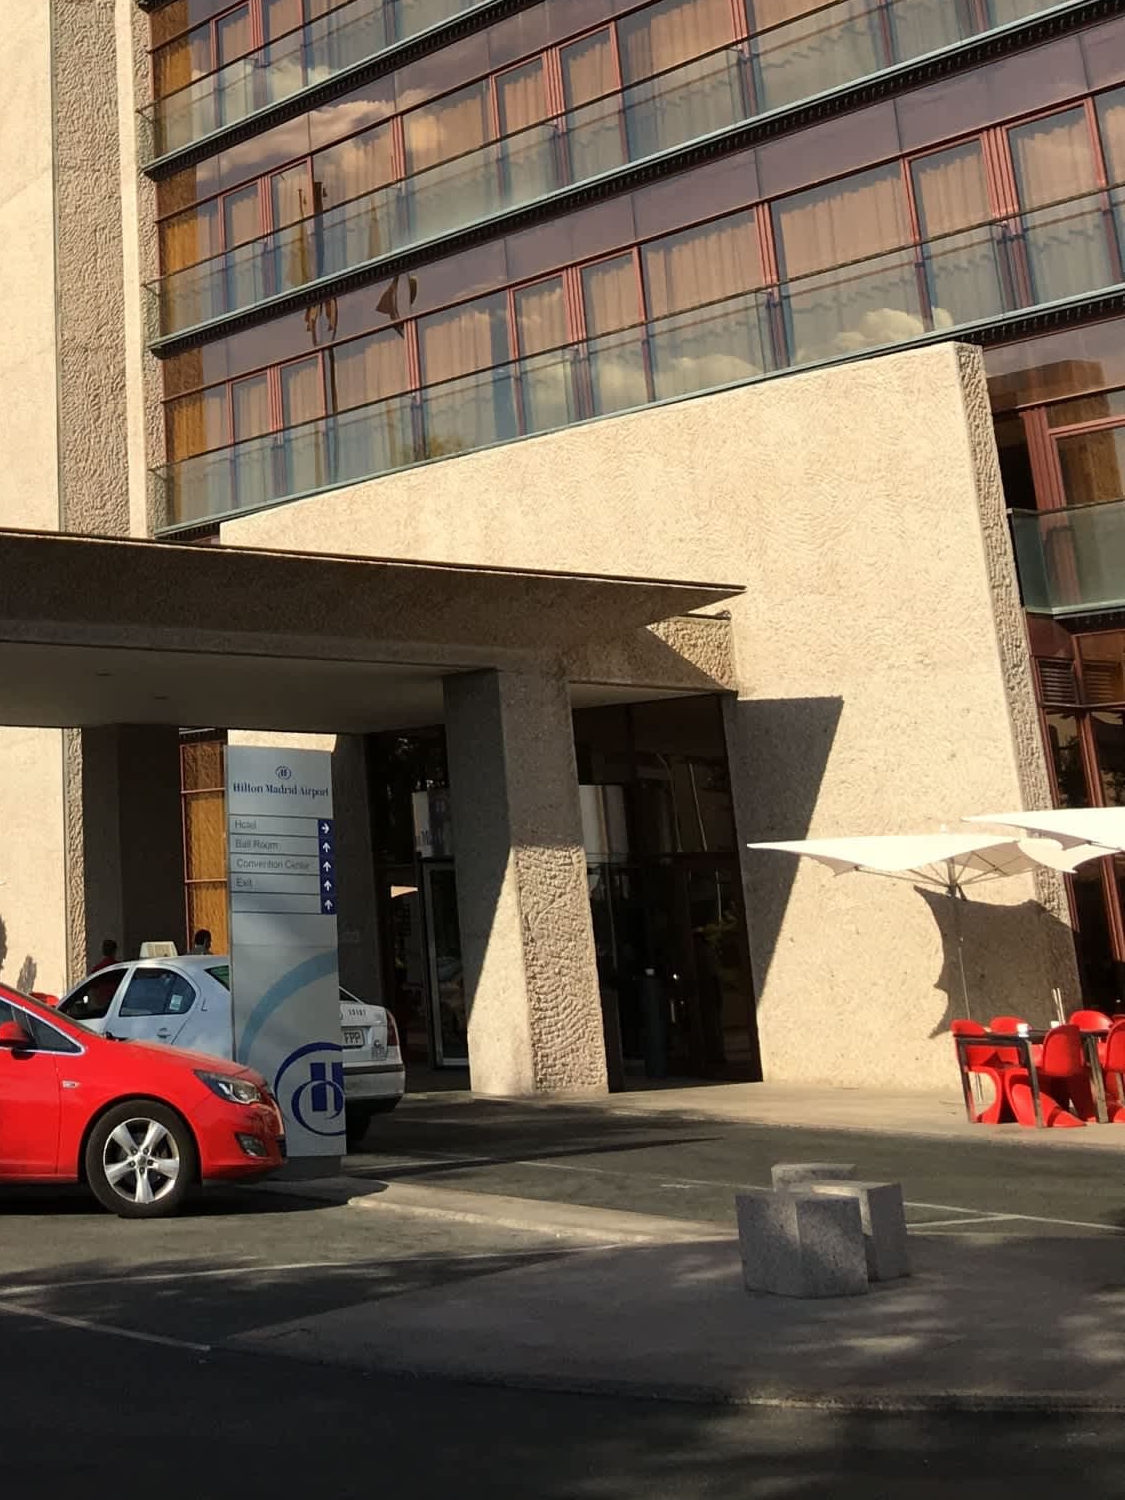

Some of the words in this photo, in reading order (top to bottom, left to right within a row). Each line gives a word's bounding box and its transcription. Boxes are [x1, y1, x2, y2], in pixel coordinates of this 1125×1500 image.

[233, 782, 263, 794] Hilton
[266, 784, 297, 796] Madrid
[299, 787, 329, 799] Airport
[253, 840, 279, 851] Room
[236, 859, 283, 869] Convention
[236, 878, 252, 888] Exit
